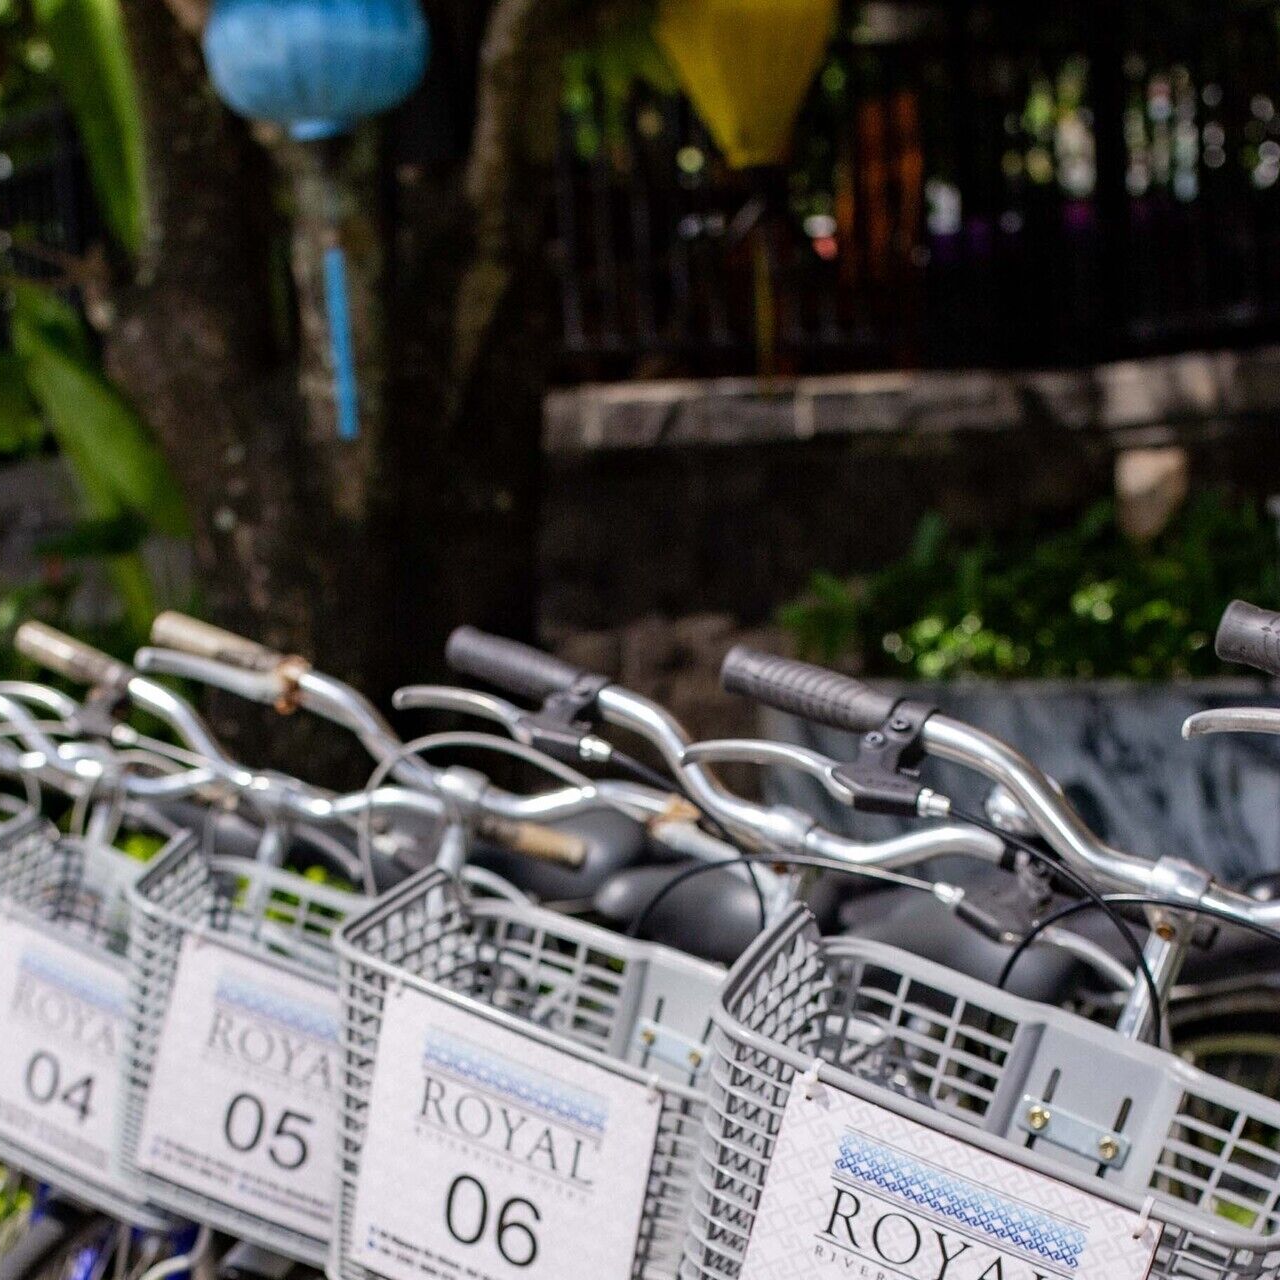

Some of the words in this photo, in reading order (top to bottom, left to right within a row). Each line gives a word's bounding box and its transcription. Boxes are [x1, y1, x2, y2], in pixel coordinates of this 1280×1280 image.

[12, 975, 117, 1056] ROYA
[207, 1008, 332, 1090] ROYA
[26, 1050, 96, 1124] 04
[225, 1092, 314, 1170] 05
[421, 1075, 593, 1185] ROYAL
[445, 1173, 541, 1267] 06
